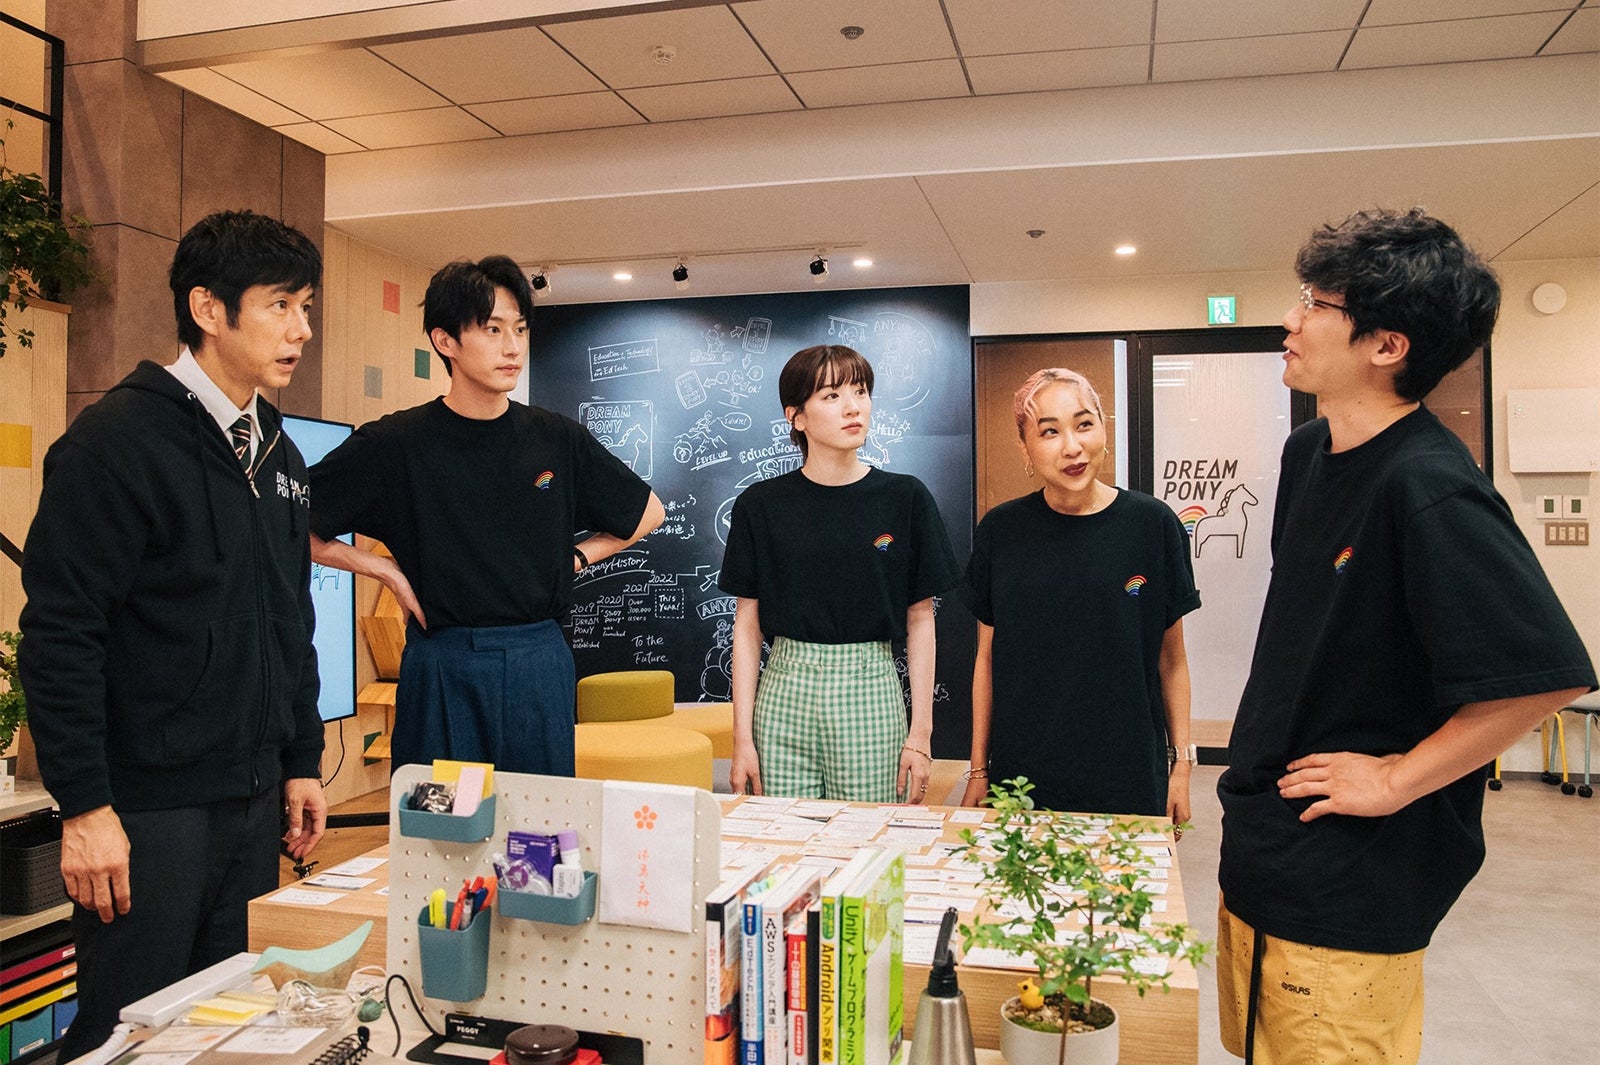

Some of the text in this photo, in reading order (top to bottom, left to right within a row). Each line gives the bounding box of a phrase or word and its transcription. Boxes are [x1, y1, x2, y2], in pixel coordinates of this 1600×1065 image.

[587, 404, 631, 420] DREAM
[587, 420, 623, 434] PONY
[1163, 458, 1238, 480] DREAM
[1163, 480, 1223, 501] PONY
[648, 574, 675, 584] 2022
[622, 583, 648, 594] 2021
[596, 595, 622, 605] 2020
[569, 602, 595, 614] 2019
[702, 598, 738, 617] ANYO
[573, 626, 595, 635] PONY
[631, 634, 664, 648] To the
[633, 651, 669, 665] Future
[456, 1025, 479, 1035] PEGGY
